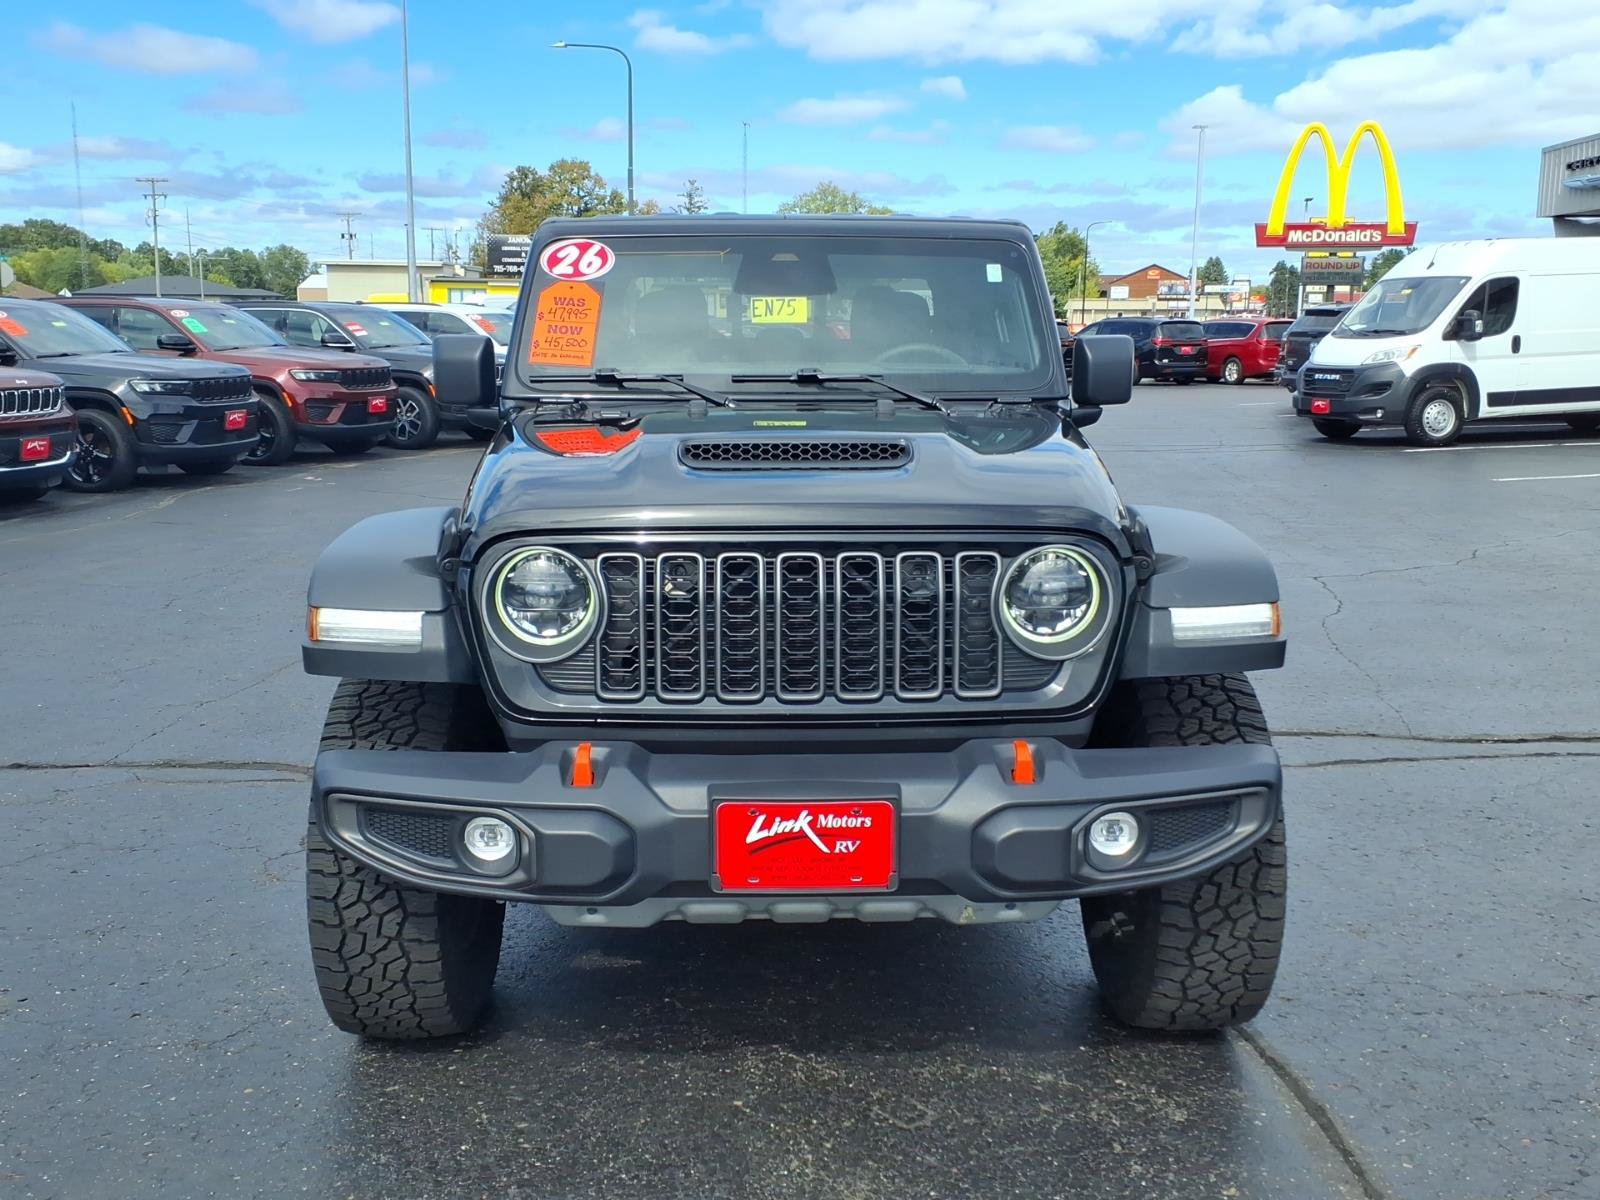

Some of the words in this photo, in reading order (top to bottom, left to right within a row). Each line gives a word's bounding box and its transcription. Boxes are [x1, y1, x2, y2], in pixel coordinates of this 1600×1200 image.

[1288, 229, 1382, 242] McDonald's
[551, 244, 603, 275] 26
[1305, 261, 1343, 270] ROUND
[1345, 261, 1360, 270] UP
[553, 296, 586, 308] WAS
[751, 299, 797, 318] EN75
[547, 325, 583, 335] NOW
[745, 809, 831, 854] Link
[816, 813, 873, 829] Motors
[834, 840, 861, 853] RV
